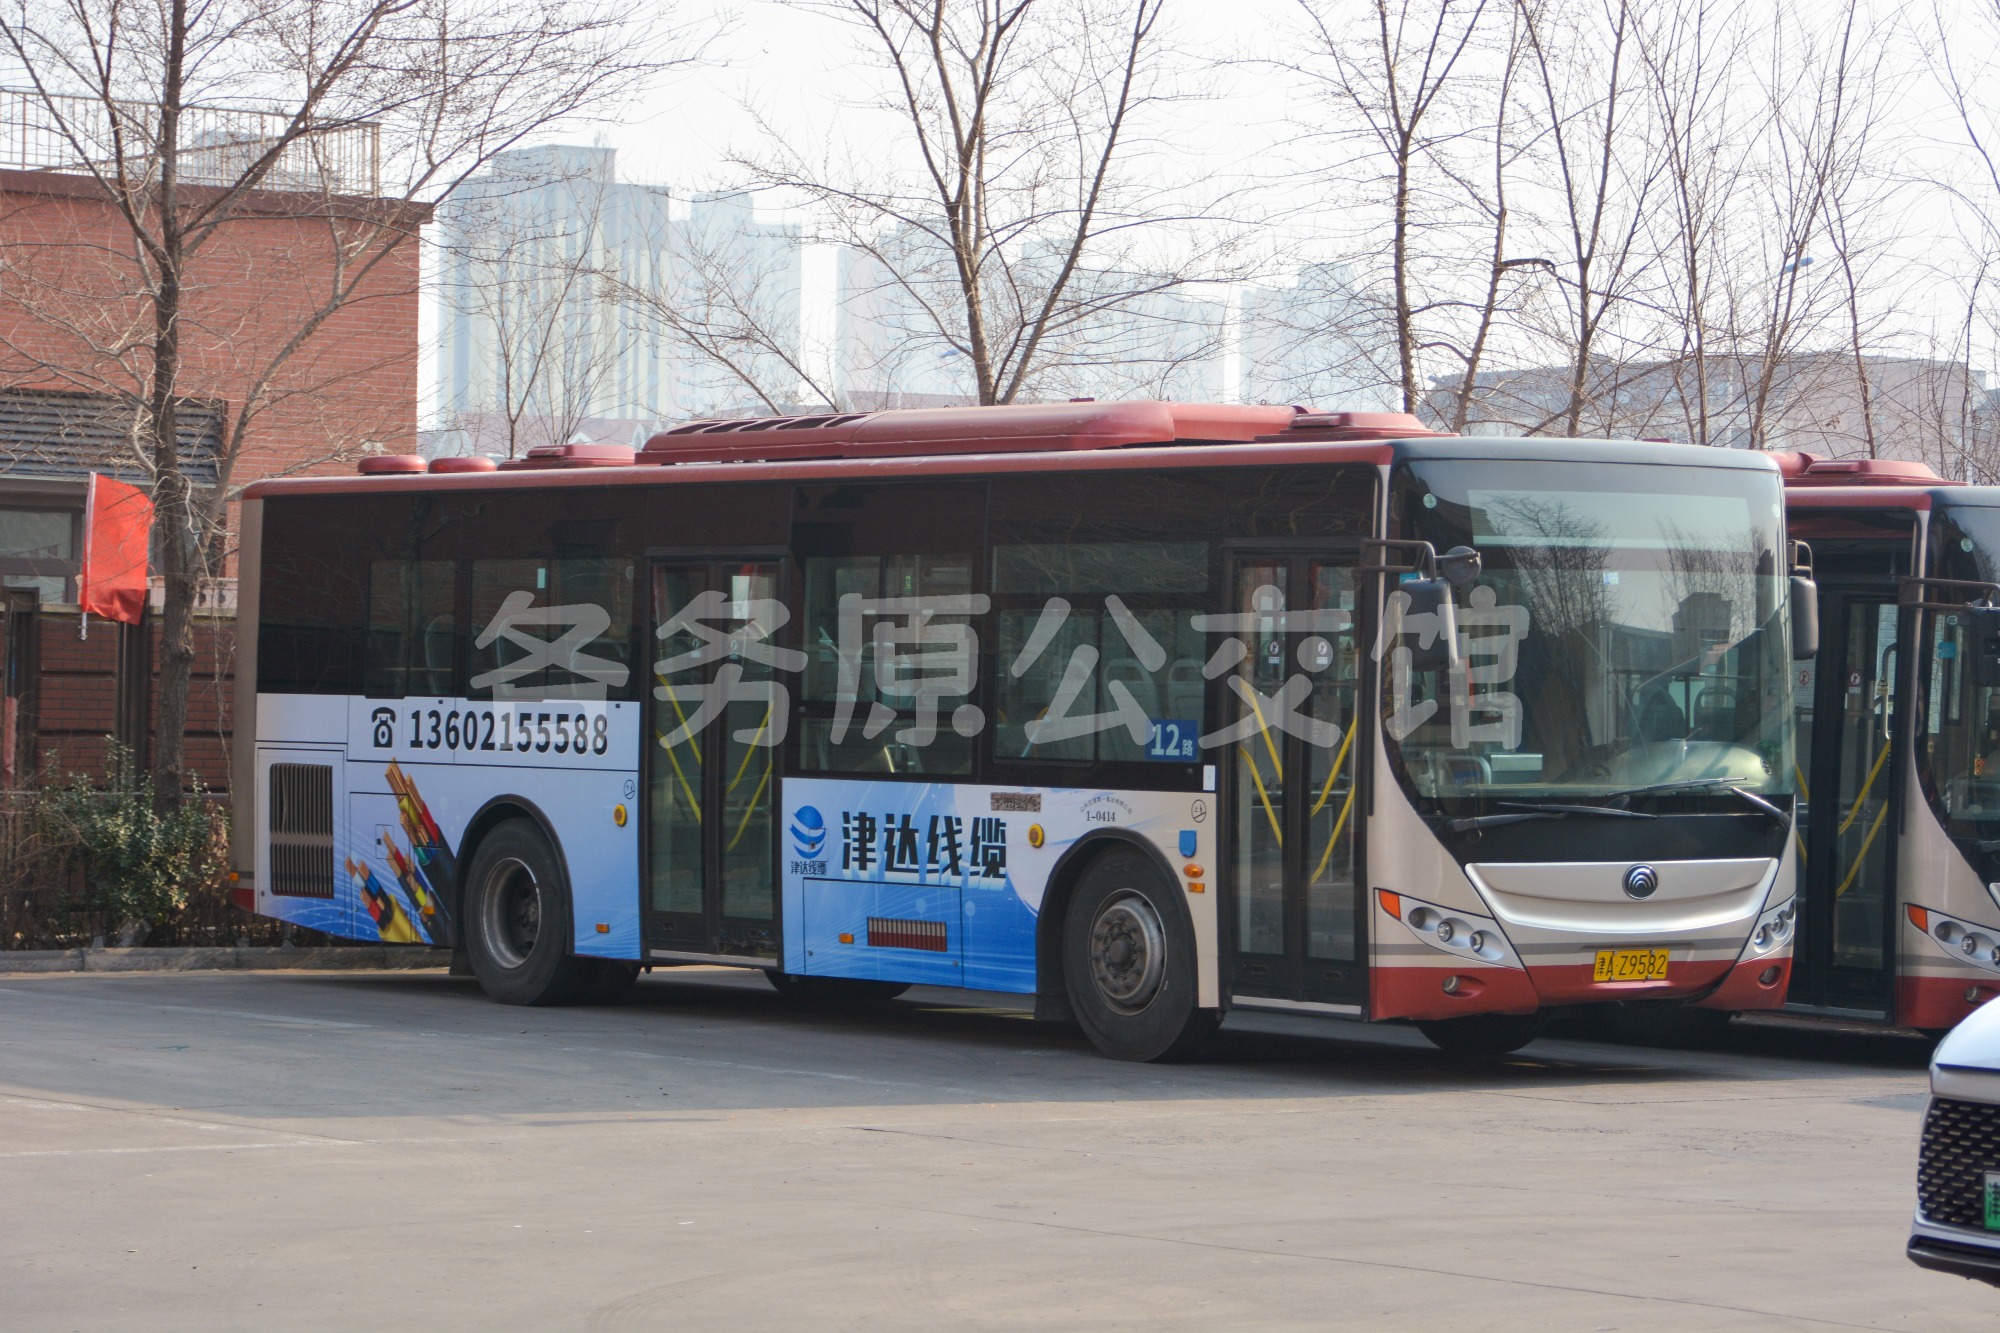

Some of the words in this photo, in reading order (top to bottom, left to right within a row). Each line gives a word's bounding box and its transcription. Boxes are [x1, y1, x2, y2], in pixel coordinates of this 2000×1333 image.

[410, 709, 608, 755] 13602155588
[1086, 810, 1116, 822] 1-0414
[842, 811, 1007, 879] 津达线缆
[790, 860, 827, 876] 津达线缆
